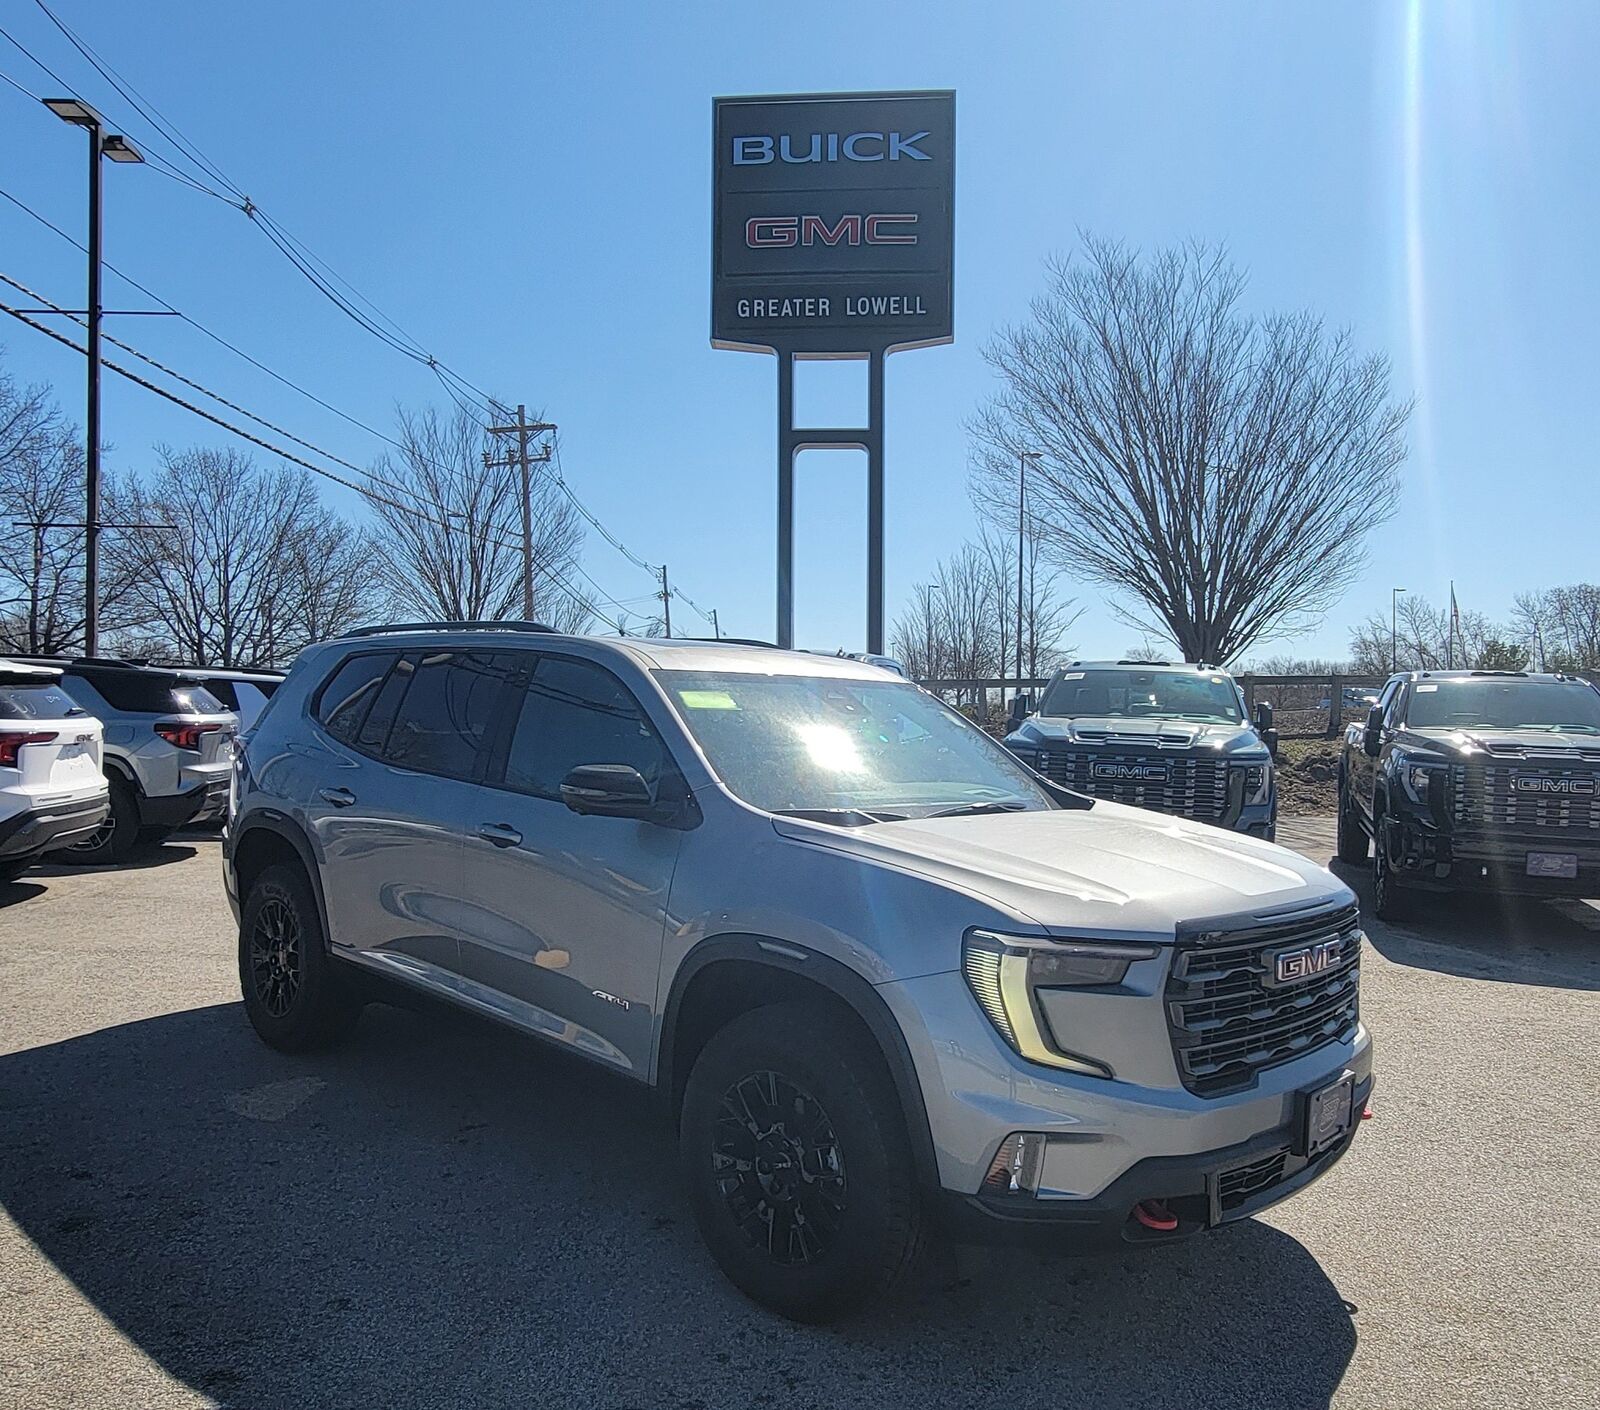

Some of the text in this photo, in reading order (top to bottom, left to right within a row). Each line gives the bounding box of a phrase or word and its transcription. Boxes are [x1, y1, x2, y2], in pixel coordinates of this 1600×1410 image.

[733, 132, 932, 165] BUICK
[746, 214, 918, 248] GMC
[737, 296, 927, 318] GREATER LOWELL
[1095, 763, 1166, 780] GMC
[1517, 777, 1594, 794] GMC
[1278, 939, 1340, 981] GMC
